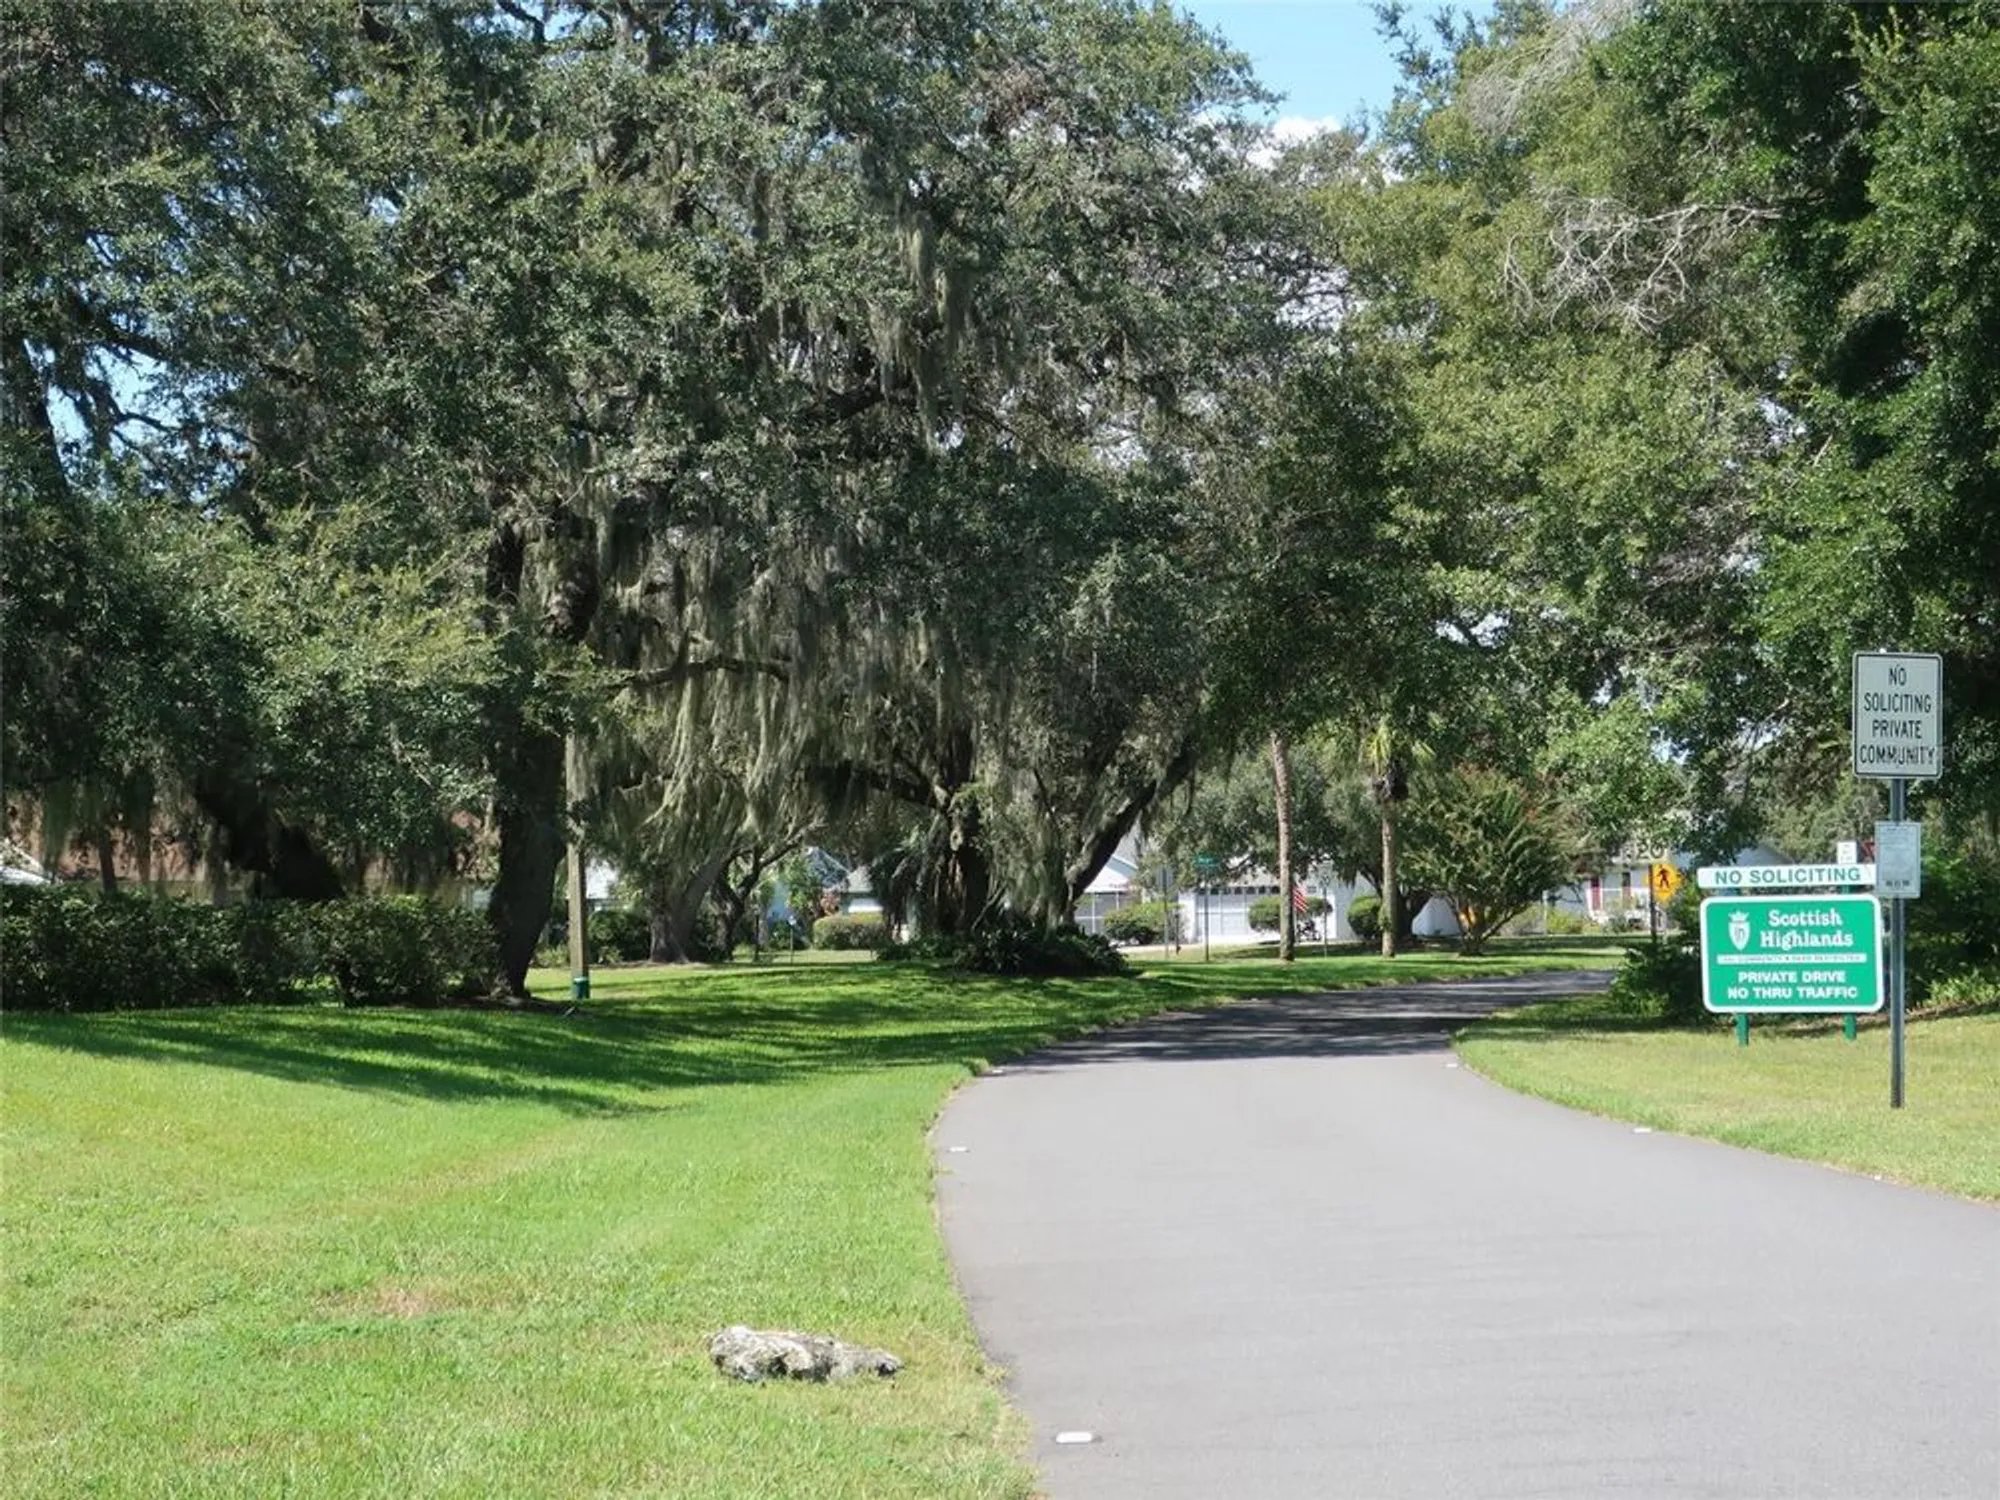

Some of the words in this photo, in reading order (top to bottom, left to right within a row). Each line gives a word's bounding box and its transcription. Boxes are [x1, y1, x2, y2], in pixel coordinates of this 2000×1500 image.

[1888, 667, 1907, 685] NO
[1863, 692, 1932, 713] SOLICITING
[1872, 720, 1922, 739] PRIVATE
[1860, 744, 1935, 765] COMMUNITY
[1715, 870, 1742, 885] NO
[1750, 867, 1861, 883] SOLICITING
[1768, 908, 1843, 927] Scottish
[1760, 929, 1853, 950] Highlands
[1738, 970, 1797, 983] PRIVATE
[1802, 970, 1847, 983] DRIVE
[1727, 987, 1748, 1000] NO
[1752, 987, 1792, 999] THRU
[1797, 986, 1858, 998] TRAFFIC
